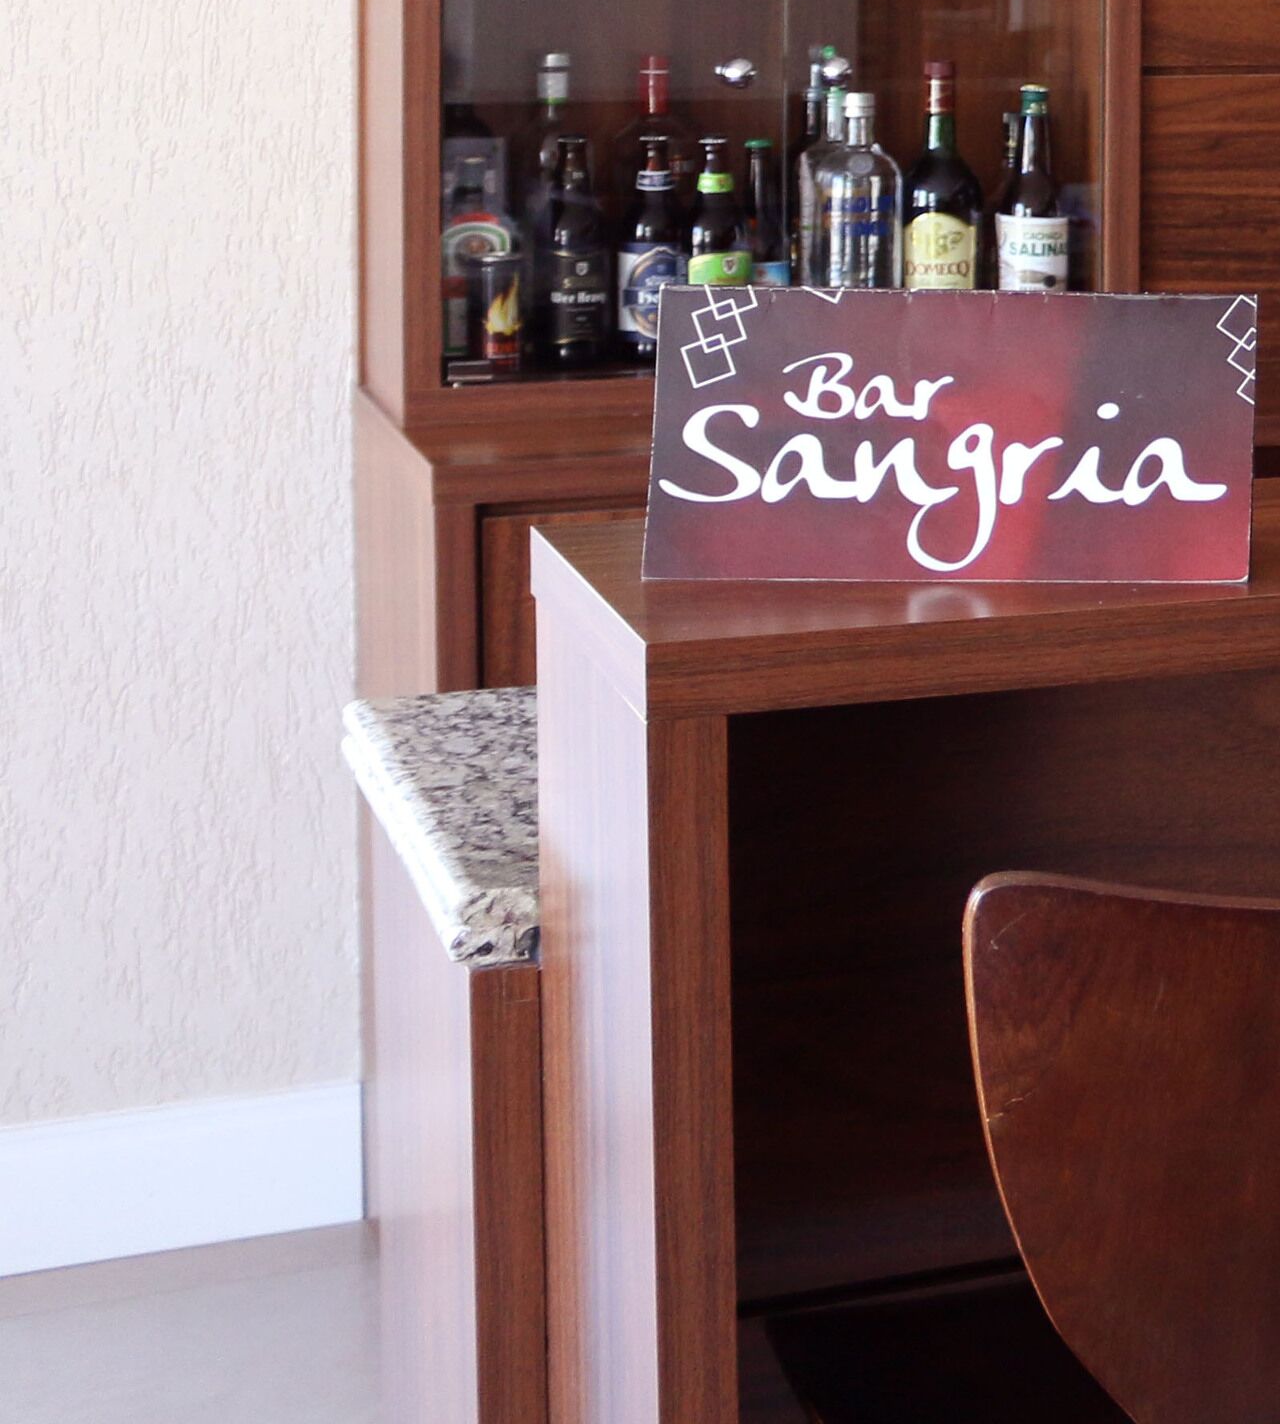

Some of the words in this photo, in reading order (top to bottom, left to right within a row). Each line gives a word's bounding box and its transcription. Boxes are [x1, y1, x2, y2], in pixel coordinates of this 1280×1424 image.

[905, 260, 970, 277] DOMECQ
[1008, 241, 1067, 257] SALINA
[782, 352, 954, 420] Bar
[658, 402, 1227, 571] Sangria
